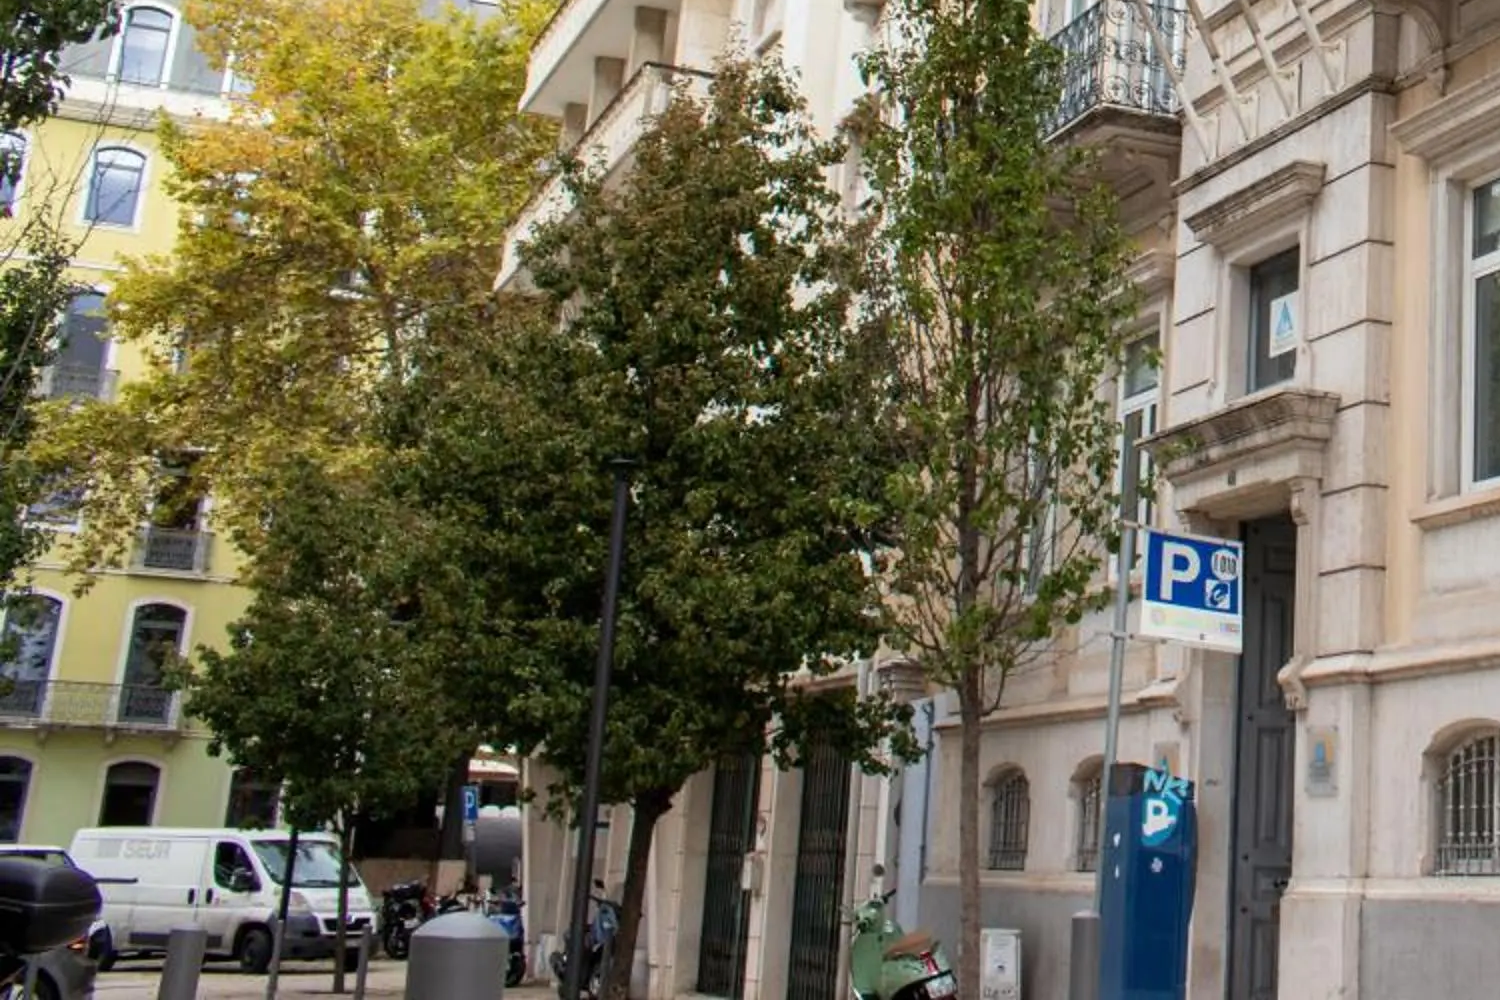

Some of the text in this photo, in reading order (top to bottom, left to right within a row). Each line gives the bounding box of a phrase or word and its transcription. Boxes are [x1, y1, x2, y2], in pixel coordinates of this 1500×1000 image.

[1160, 541, 1201, 601] P
[464, 791, 476, 817] P
[122, 840, 171, 859] SEUR
